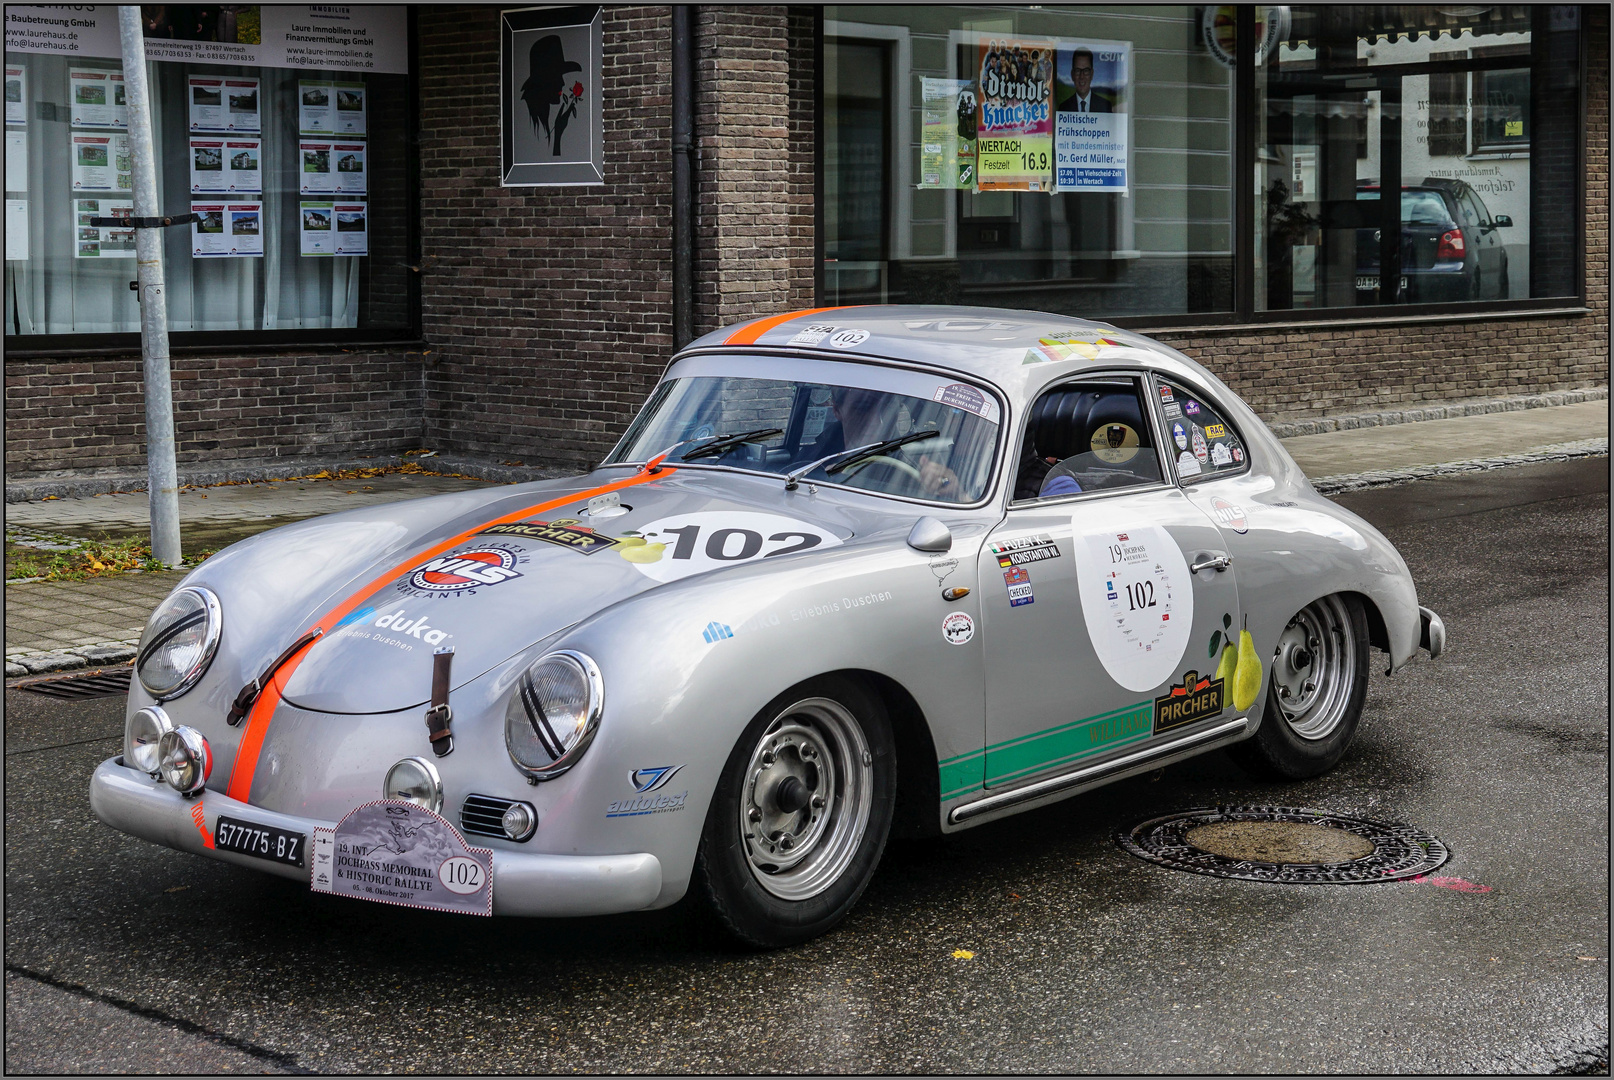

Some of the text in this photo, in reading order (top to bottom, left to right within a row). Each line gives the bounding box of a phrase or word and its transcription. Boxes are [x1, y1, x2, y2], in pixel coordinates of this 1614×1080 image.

[12, 14, 69, 28] Baubetreuung
[70, 19, 96, 28] GmbH
[292, 24, 311, 32] Laure
[312, 26, 351, 35] Immobilien
[6, 39, 78, 50] nfo@laurehaus.de
[144, 41, 193, 50] chimmelreiterweg
[286, 34, 350, 46] Finanzvermittlungs
[286, 47, 373, 58] www.laure-immobilien.de
[1099, 52, 1116, 61] CSU
[286, 56, 374, 68] info@laure-immobilien.de
[1058, 114, 1098, 124] Politischer
[1058, 127, 1110, 139] Frühschoppen
[980, 141, 1021, 152] WERTACH
[1058, 141, 1124, 150] mit Bundesminister
[984, 160, 1010, 169] Festzelt
[1022, 152, 1050, 170] 16.9.
[1058, 154, 1068, 162] Dr.
[1070, 154, 1088, 162] Gerd
[1090, 154, 1115, 164] Müller,
[834, 333, 864, 344] 102
[944, 396, 979, 410] DURCHFAHRT
[956, 393, 972, 401] FREIE
[1210, 426, 1223, 434] RAC
[1215, 506, 1246, 523] NILS
[485, 524, 595, 548] PIRCHER
[663, 524, 822, 560] 102
[1002, 536, 1032, 550] FUZZY
[452, 542, 526, 553] EXPERTS
[1109, 544, 1146, 563] 19. JOCHPASS
[1010, 546, 1059, 565] KONSTANTIN W.
[410, 558, 519, 584] NILS
[1010, 586, 1032, 598] CHECKED
[1126, 580, 1156, 611] 102
[791, 601, 840, 621] Erlebnis
[842, 590, 892, 609] Duschen
[375, 610, 448, 646] duka
[337, 630, 413, 652] Erlebnis Duschen
[1160, 691, 1218, 723] PIRCHER
[1090, 710, 1150, 744] WILLIAMS
[606, 790, 688, 813] autotest
[190, 800, 206, 828] TOW
[219, 823, 270, 853] 577775
[339, 844, 349, 853] 19.
[338, 856, 433, 878] JOCHPASS MEMORIAL
[448, 862, 479, 886] 102
[337, 869, 432, 891] & HISTORIC RALLYE
[375, 888, 398, 897] Oktober
[400, 891, 414, 899] 2017
